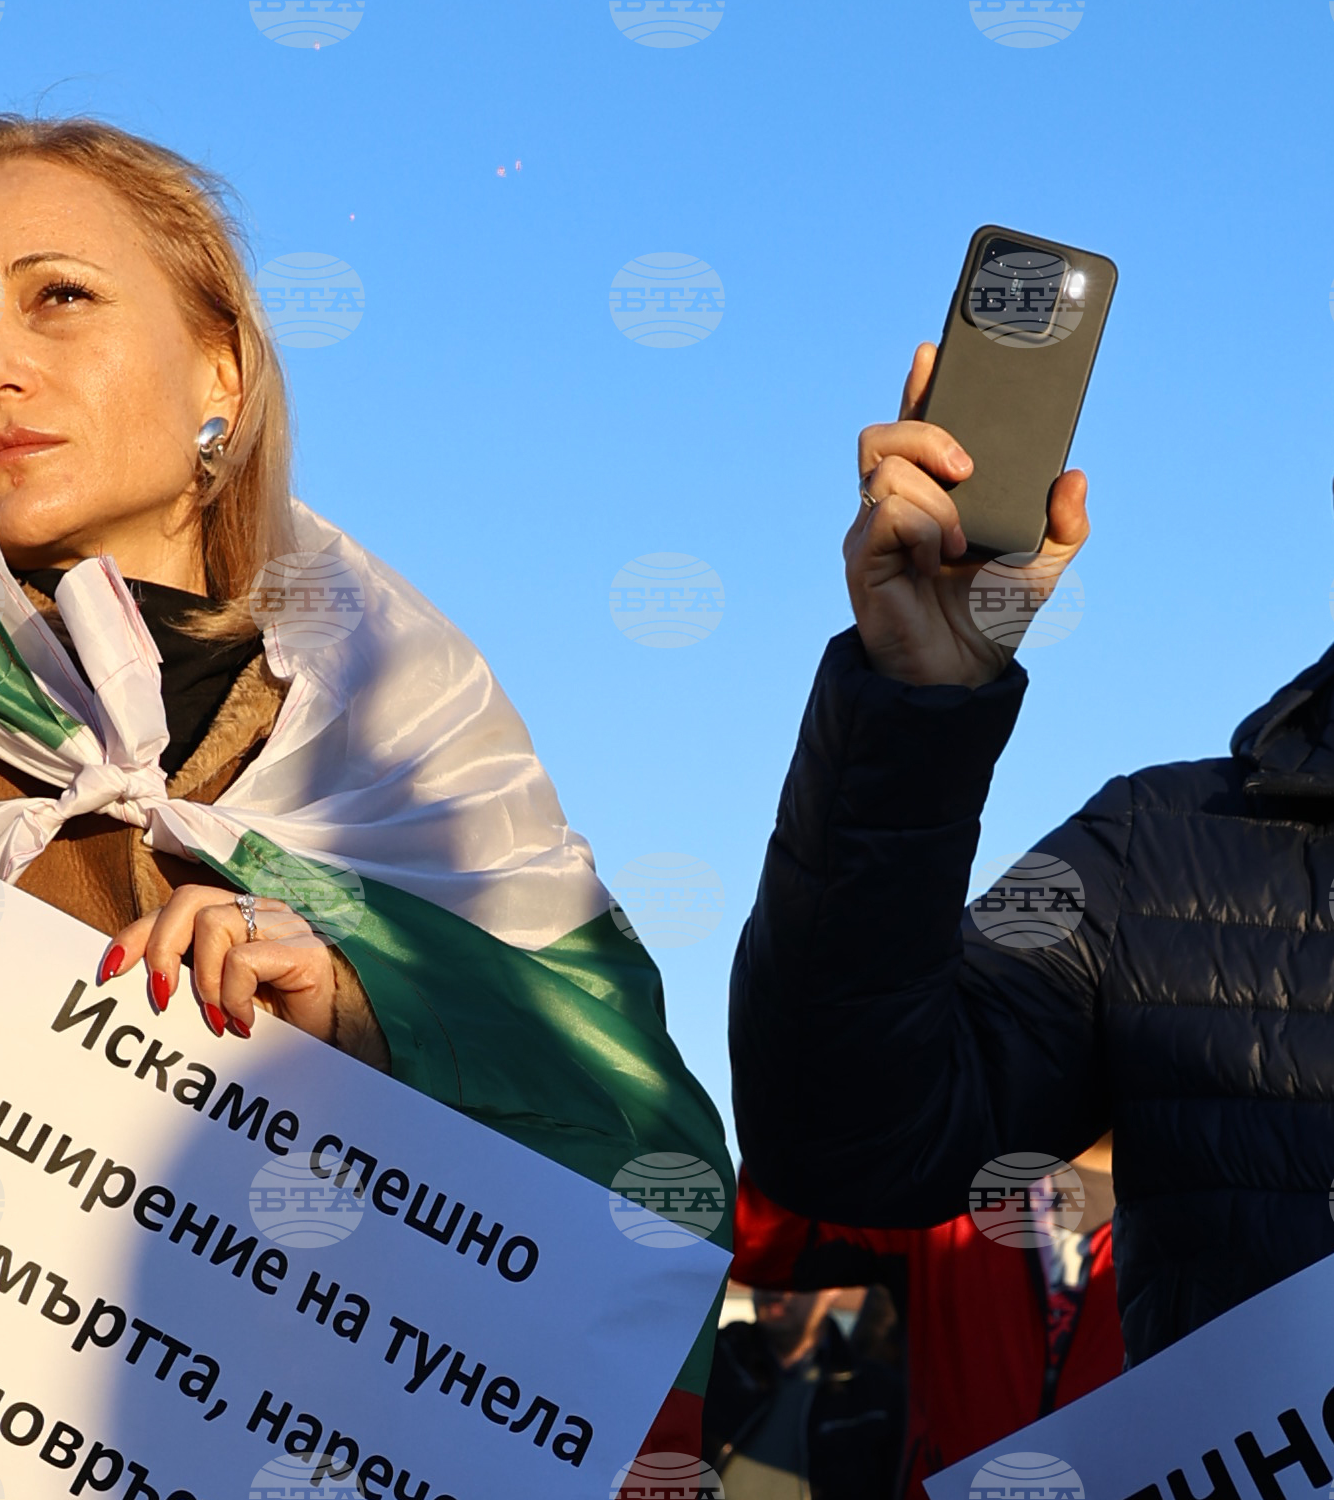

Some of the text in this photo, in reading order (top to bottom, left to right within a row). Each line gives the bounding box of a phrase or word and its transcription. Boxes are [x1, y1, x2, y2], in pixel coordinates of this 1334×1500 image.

[51, 980, 538, 1282] Искаме спешно
[297, 1271, 370, 1343] на
[385, 1317, 593, 1467] тунела
